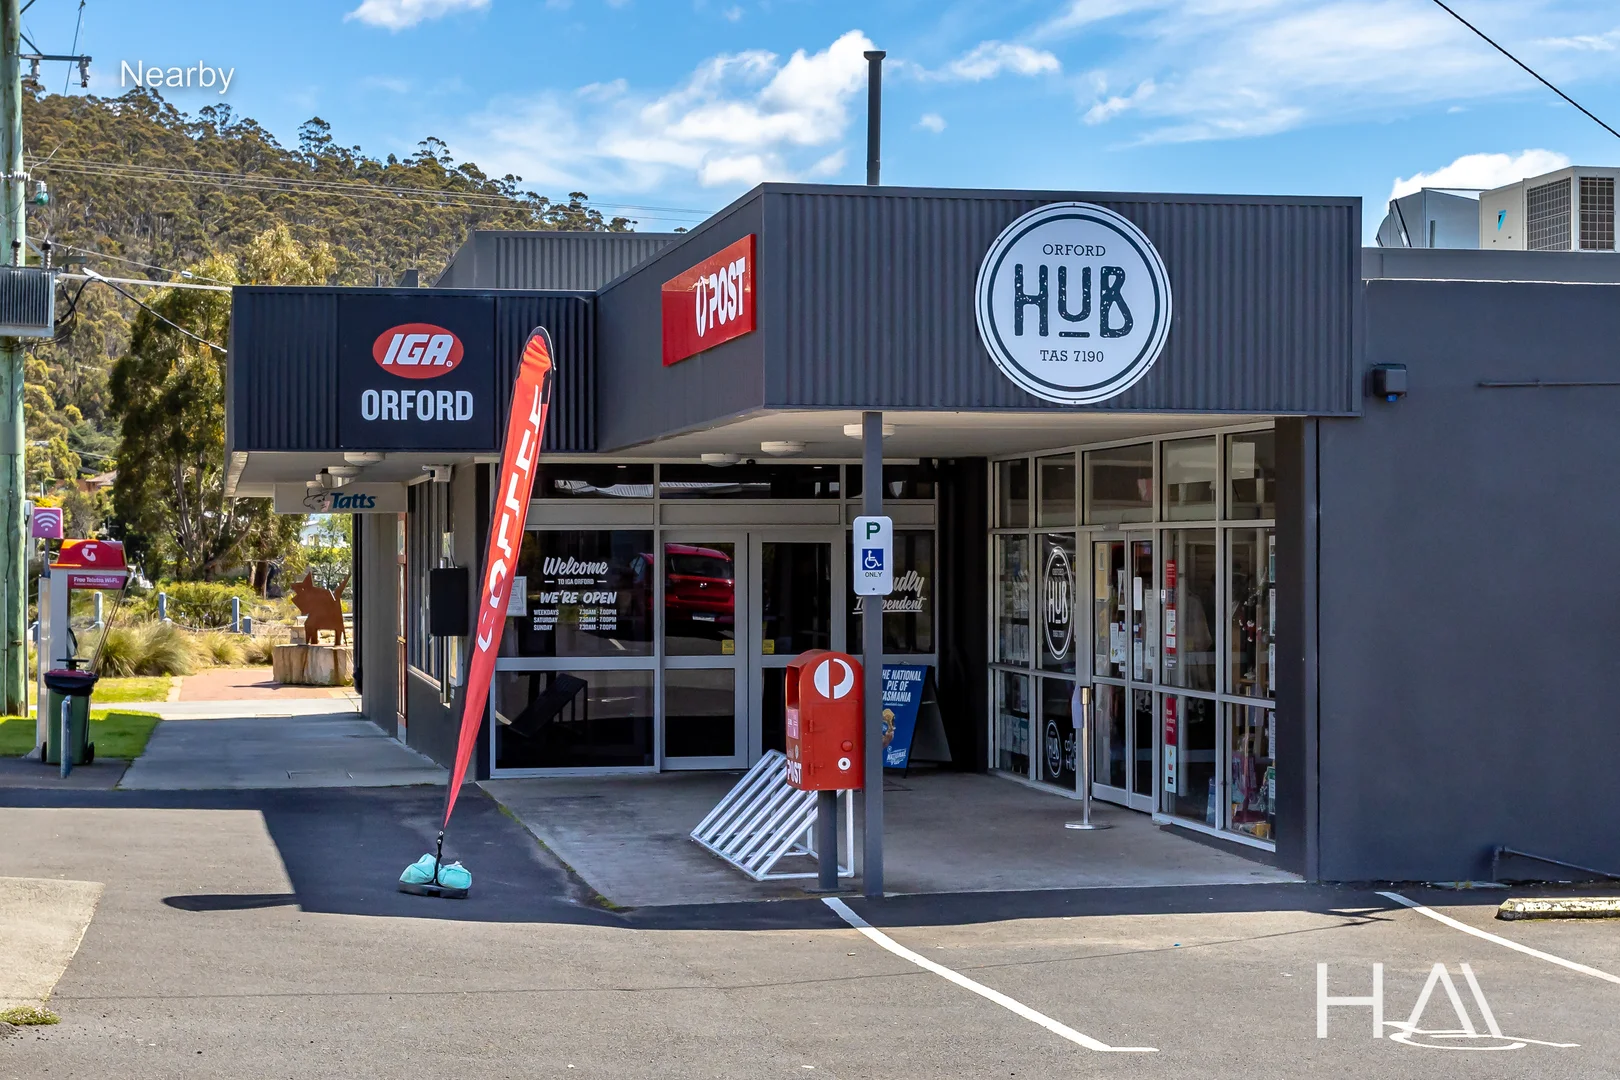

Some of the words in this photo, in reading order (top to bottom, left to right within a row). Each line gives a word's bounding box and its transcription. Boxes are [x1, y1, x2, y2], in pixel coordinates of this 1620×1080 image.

[1042, 244, 1106, 256] ORFORD
[709, 256, 746, 329] POST
[1014, 263, 1134, 338] HUB
[382, 333, 454, 367] IGA
[1040, 350, 1068, 362] TAS
[1073, 351, 1104, 362] 7190
[361, 389, 474, 421] ORFORD
[330, 492, 378, 509] Tatts
[866, 521, 881, 540] P
[543, 556, 609, 576] Welcome
[540, 590, 579, 604] WE'RE
[582, 591, 617, 604] OPEN
[1048, 580, 1068, 625] HUB
[891, 669, 922, 681] NATIONAL
[886, 680, 899, 691] PIE
[899, 680, 910, 691] OF
[787, 760, 802, 785] POST
